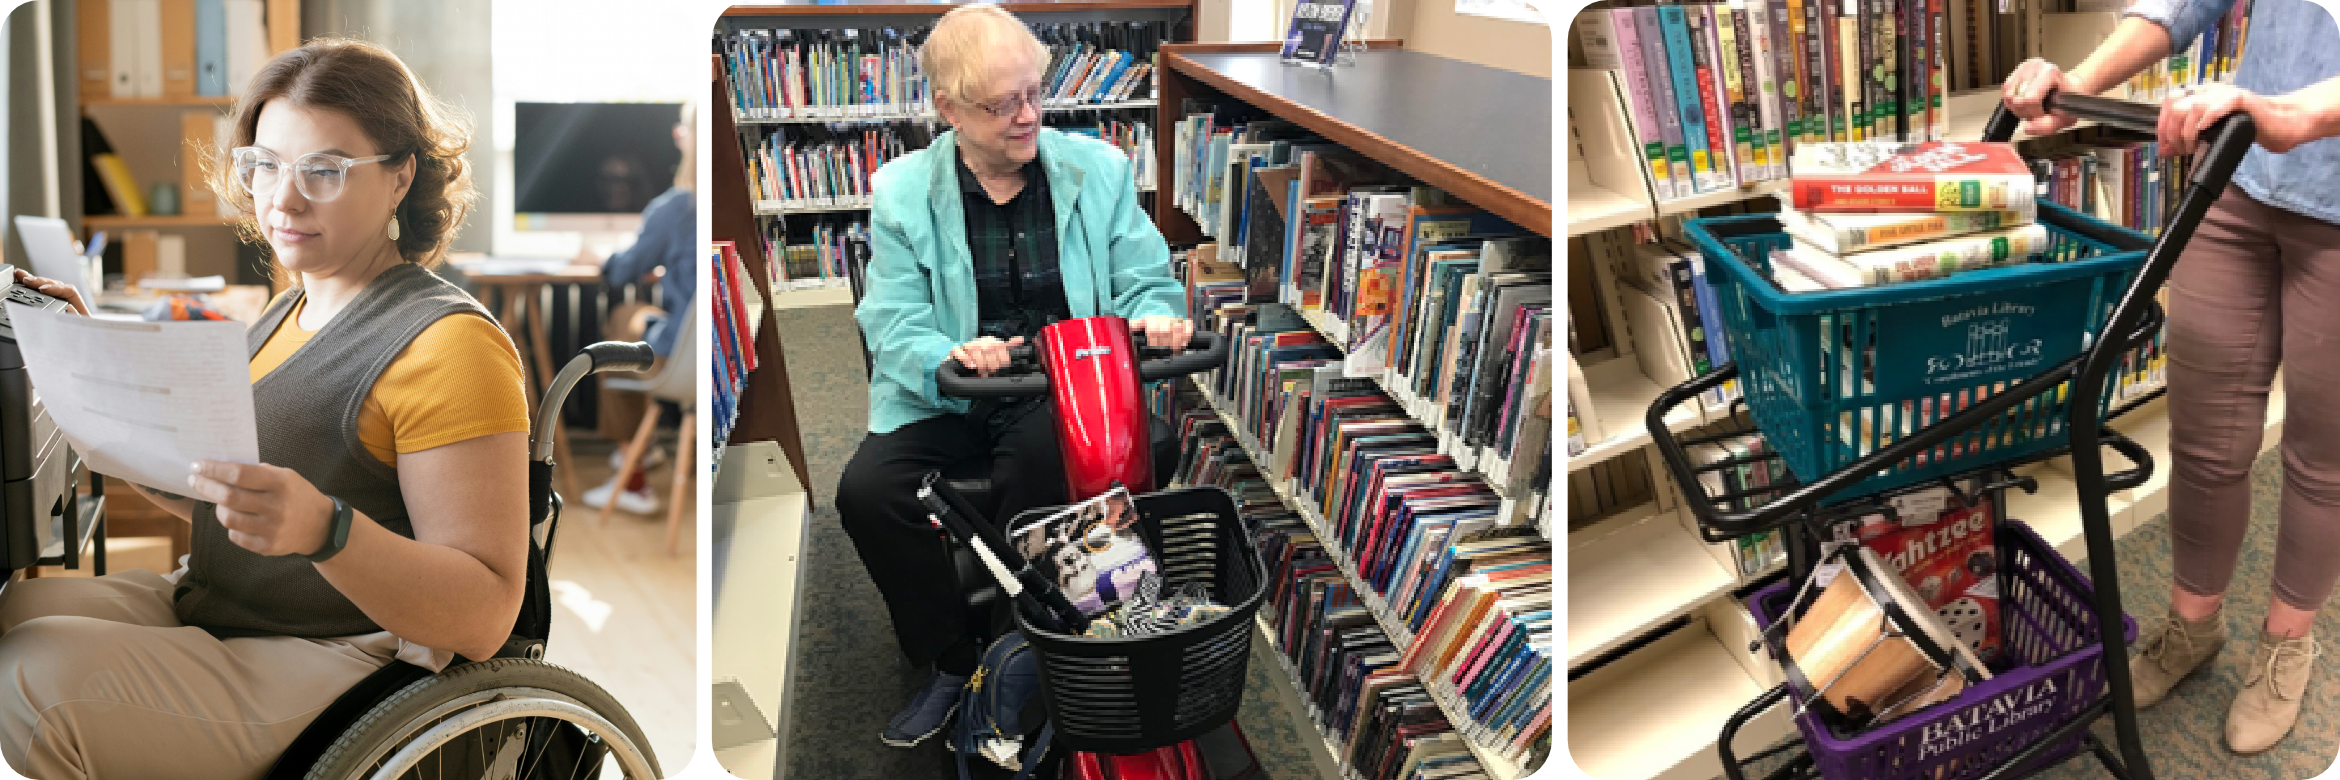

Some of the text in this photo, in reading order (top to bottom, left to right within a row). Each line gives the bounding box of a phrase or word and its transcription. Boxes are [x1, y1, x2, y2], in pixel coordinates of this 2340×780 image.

[1830, 184, 1929, 195] THE GOLDEN BALL
[1942, 302, 2035, 327] Batavia Library
[1918, 696, 2057, 761] Public Library
[1921, 677, 2058, 745] BATAVIA
